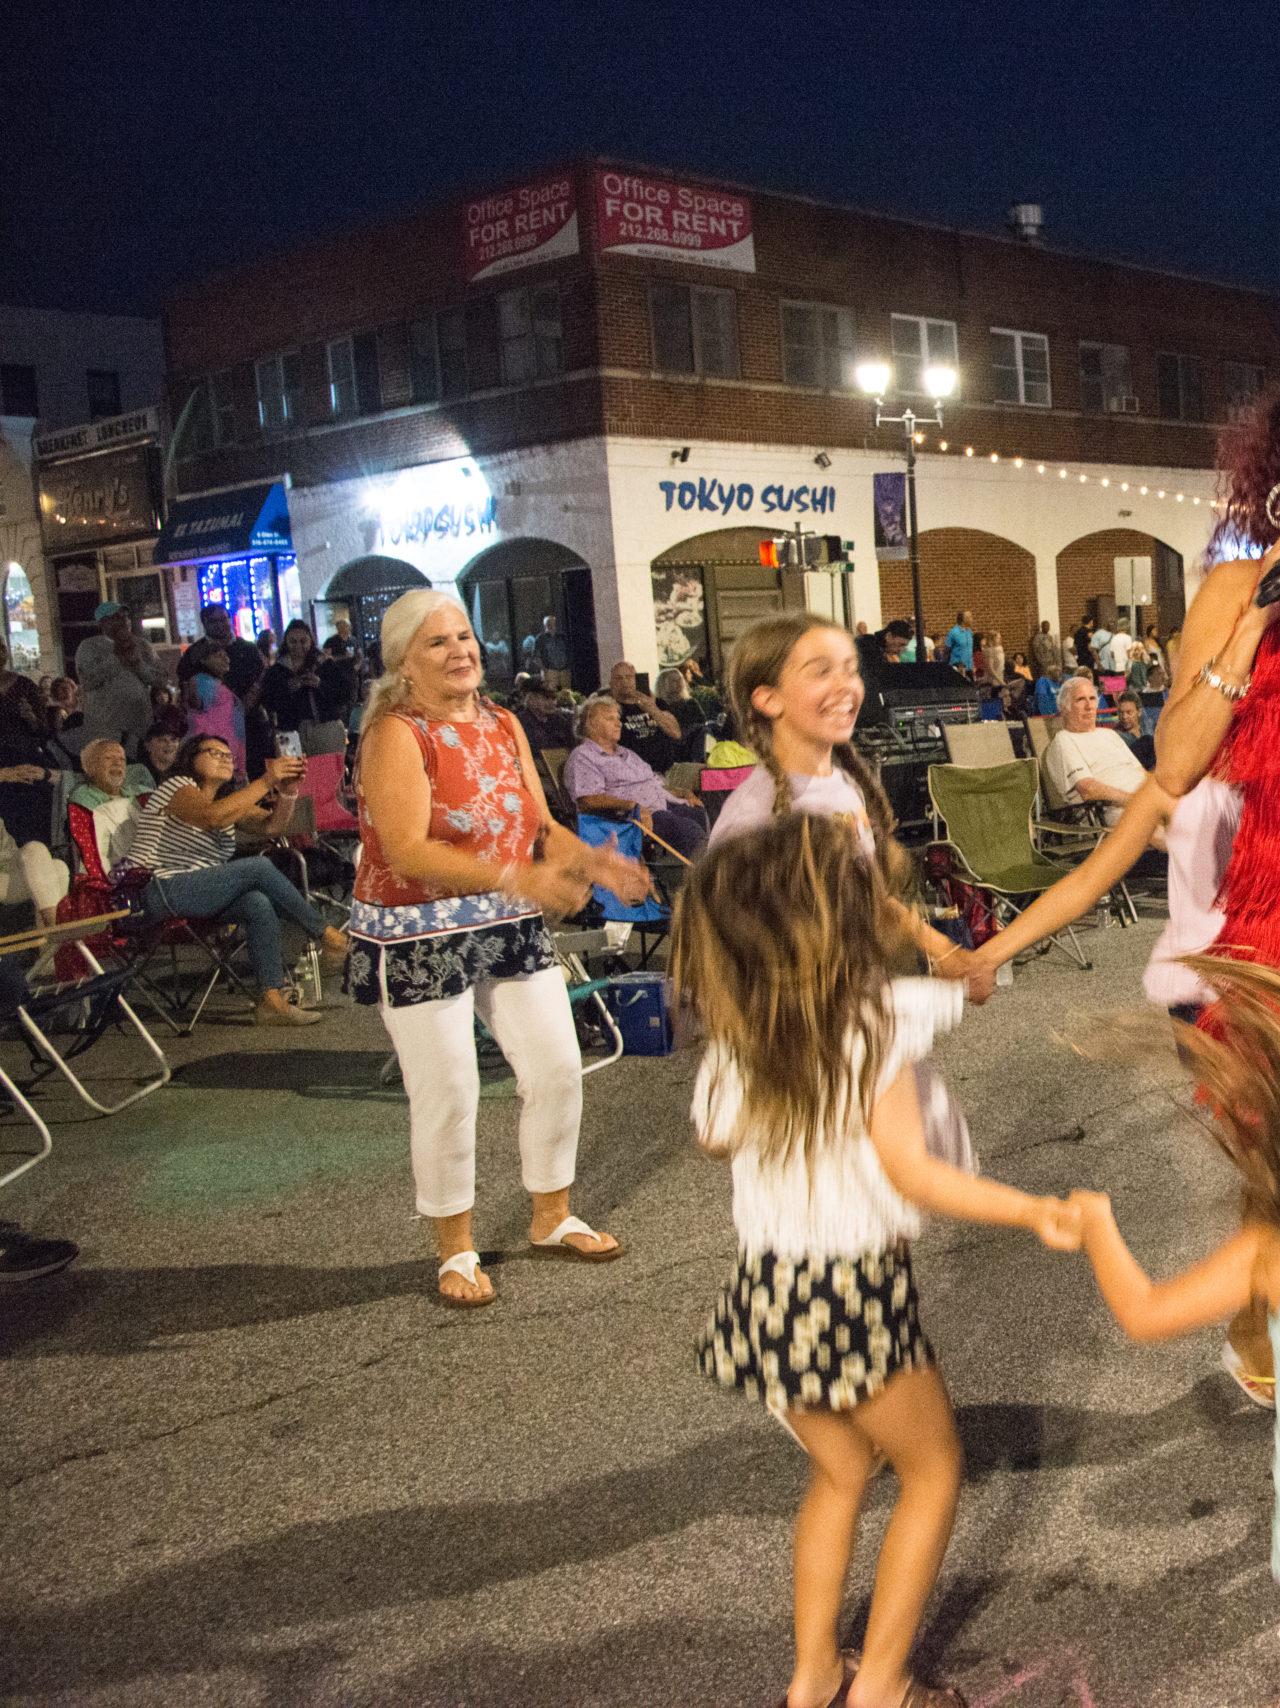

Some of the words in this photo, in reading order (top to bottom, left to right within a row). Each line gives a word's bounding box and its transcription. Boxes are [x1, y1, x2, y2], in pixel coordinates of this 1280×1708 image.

[467, 198, 514, 225] Office
[519, 181, 570, 211] Space
[603, 173, 671, 205] Office
[677, 187, 744, 218] Space
[469, 219, 509, 248] FOR
[514, 200, 568, 234] RENT
[605, 198, 665, 226] FOR
[671, 210, 743, 238] RENT
[659, 477, 754, 516] TOKYO
[760, 484, 836, 514] SUSHI
